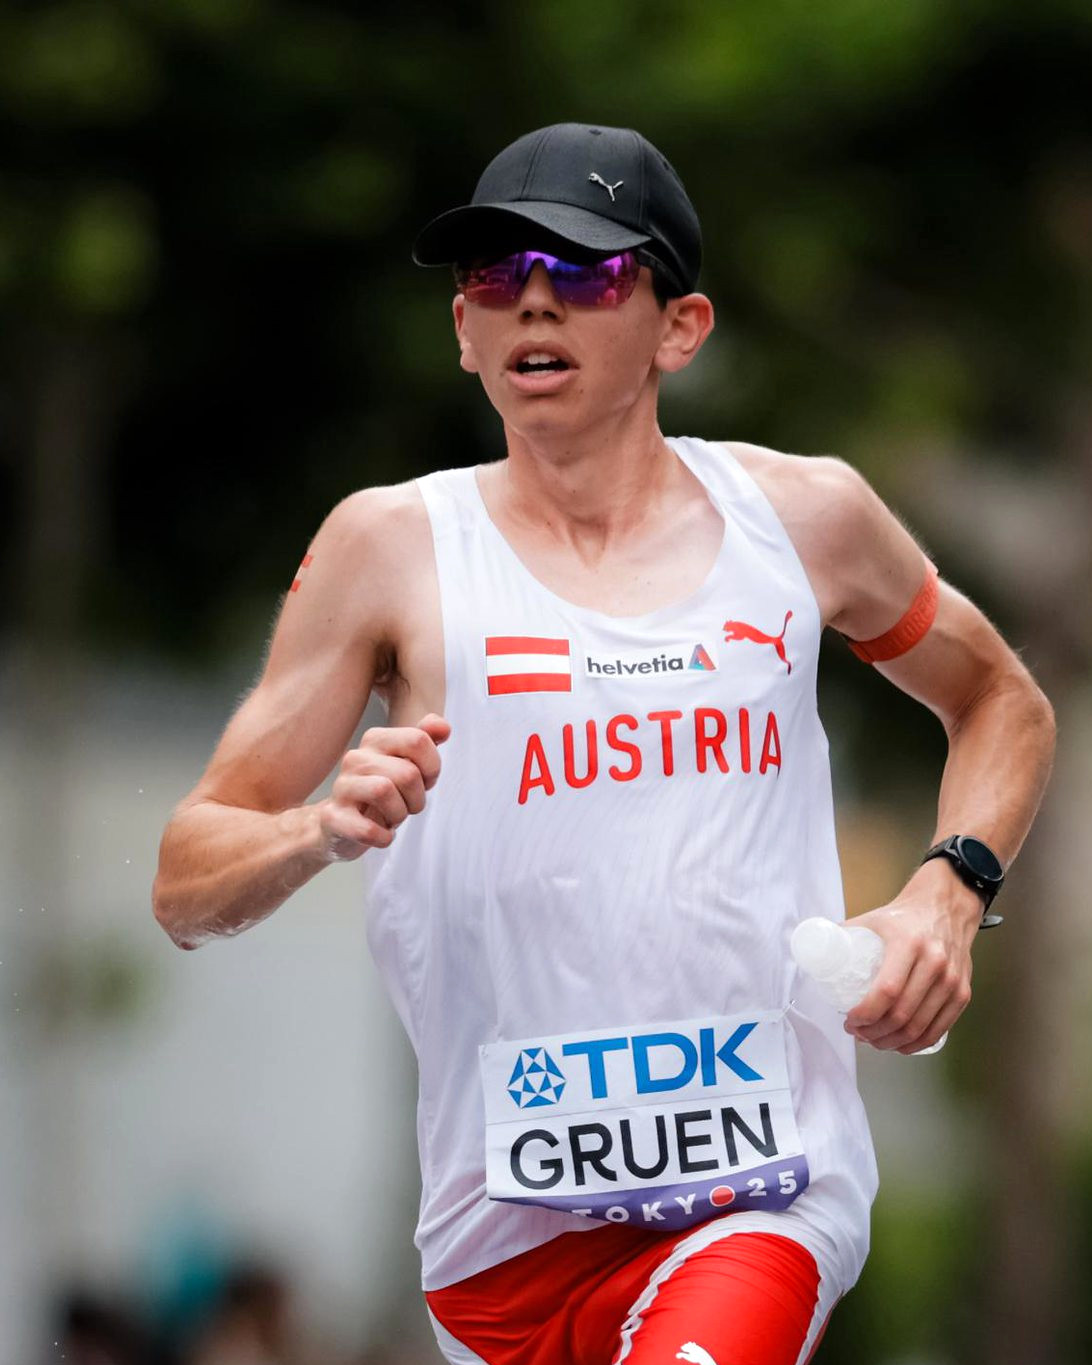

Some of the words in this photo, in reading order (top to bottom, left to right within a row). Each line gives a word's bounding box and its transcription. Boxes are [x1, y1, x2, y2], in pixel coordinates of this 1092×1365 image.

[587, 654, 684, 676] helvetia
[517, 707, 782, 805] AUSTRIA
[562, 1022, 765, 1099] TDK
[510, 1102, 779, 1190] GRUEN
